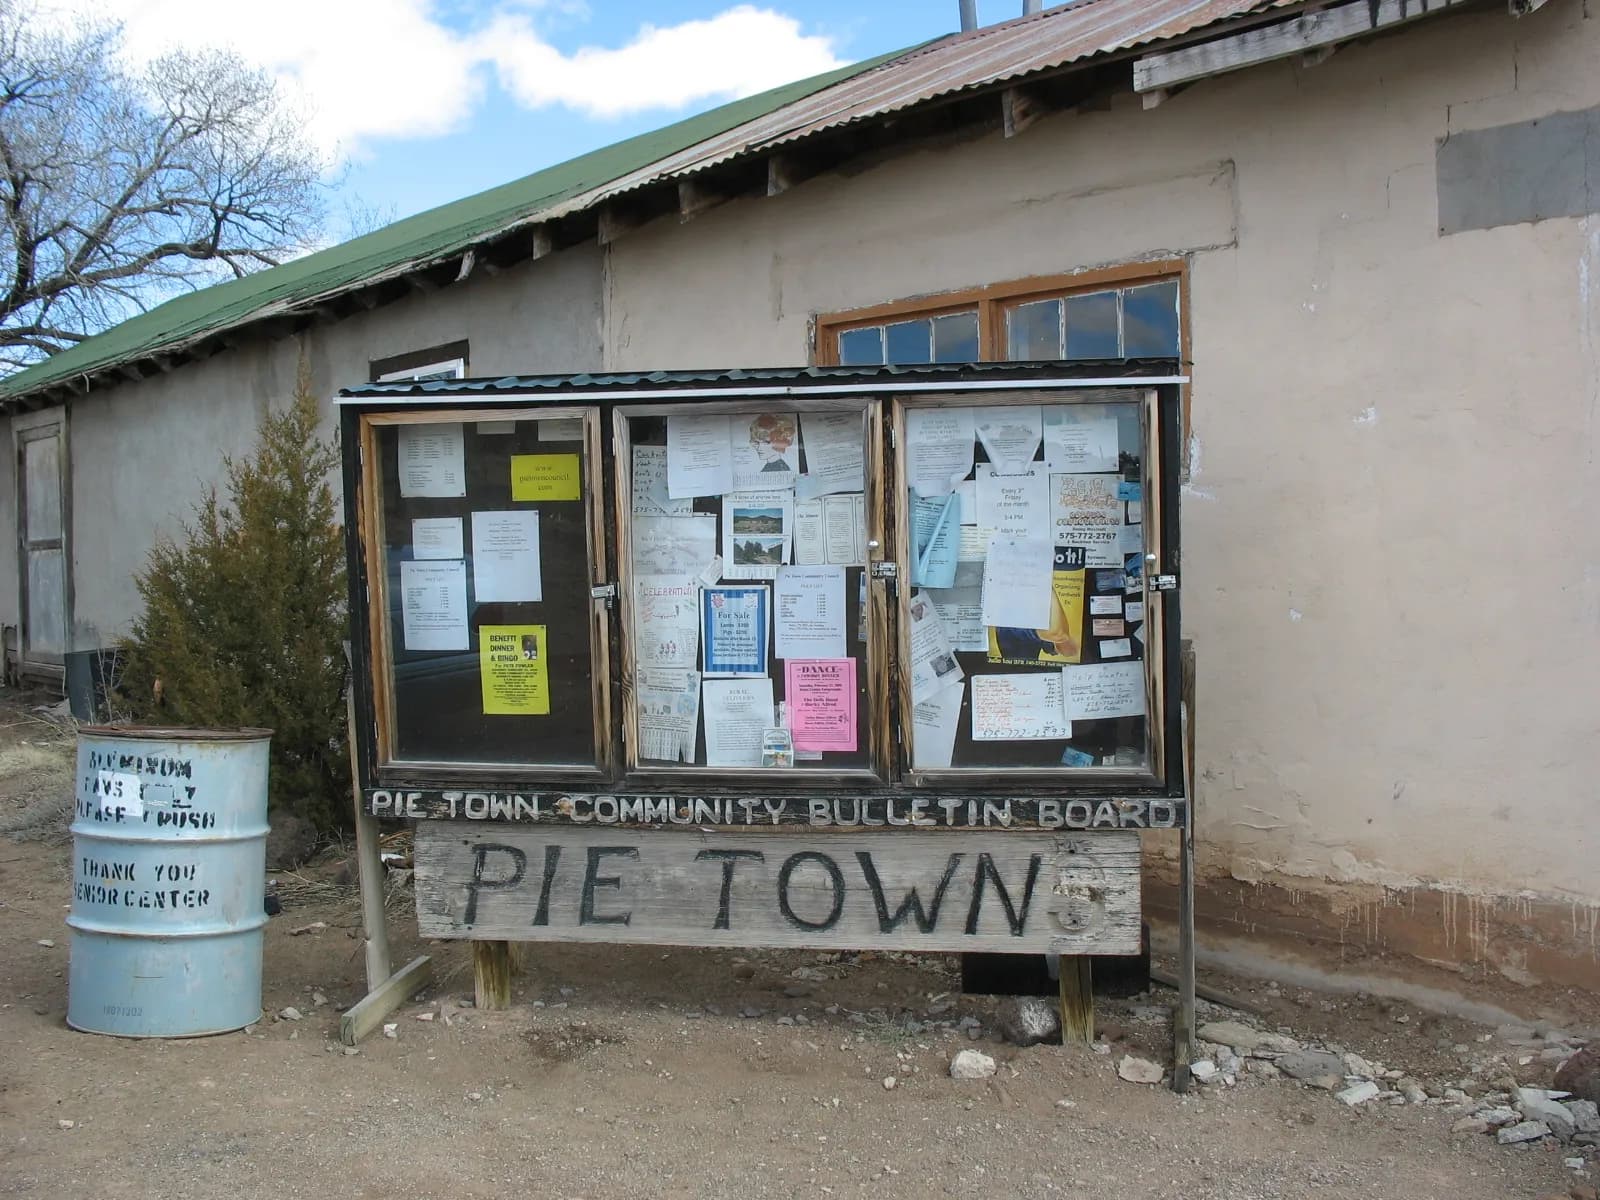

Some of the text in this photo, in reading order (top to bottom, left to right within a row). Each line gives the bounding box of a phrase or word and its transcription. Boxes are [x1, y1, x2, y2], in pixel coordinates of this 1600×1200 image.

[1059, 532, 1117, 540] 575-772-2767
[371, 790, 1177, 828] PIE TOWN COMMUNITY BULLETIN BOARD
[83, 858, 195, 882] THANK YOU
[74, 881, 210, 908] SENIOR CENTER
[462, 842, 1042, 937] PIE TOWN
